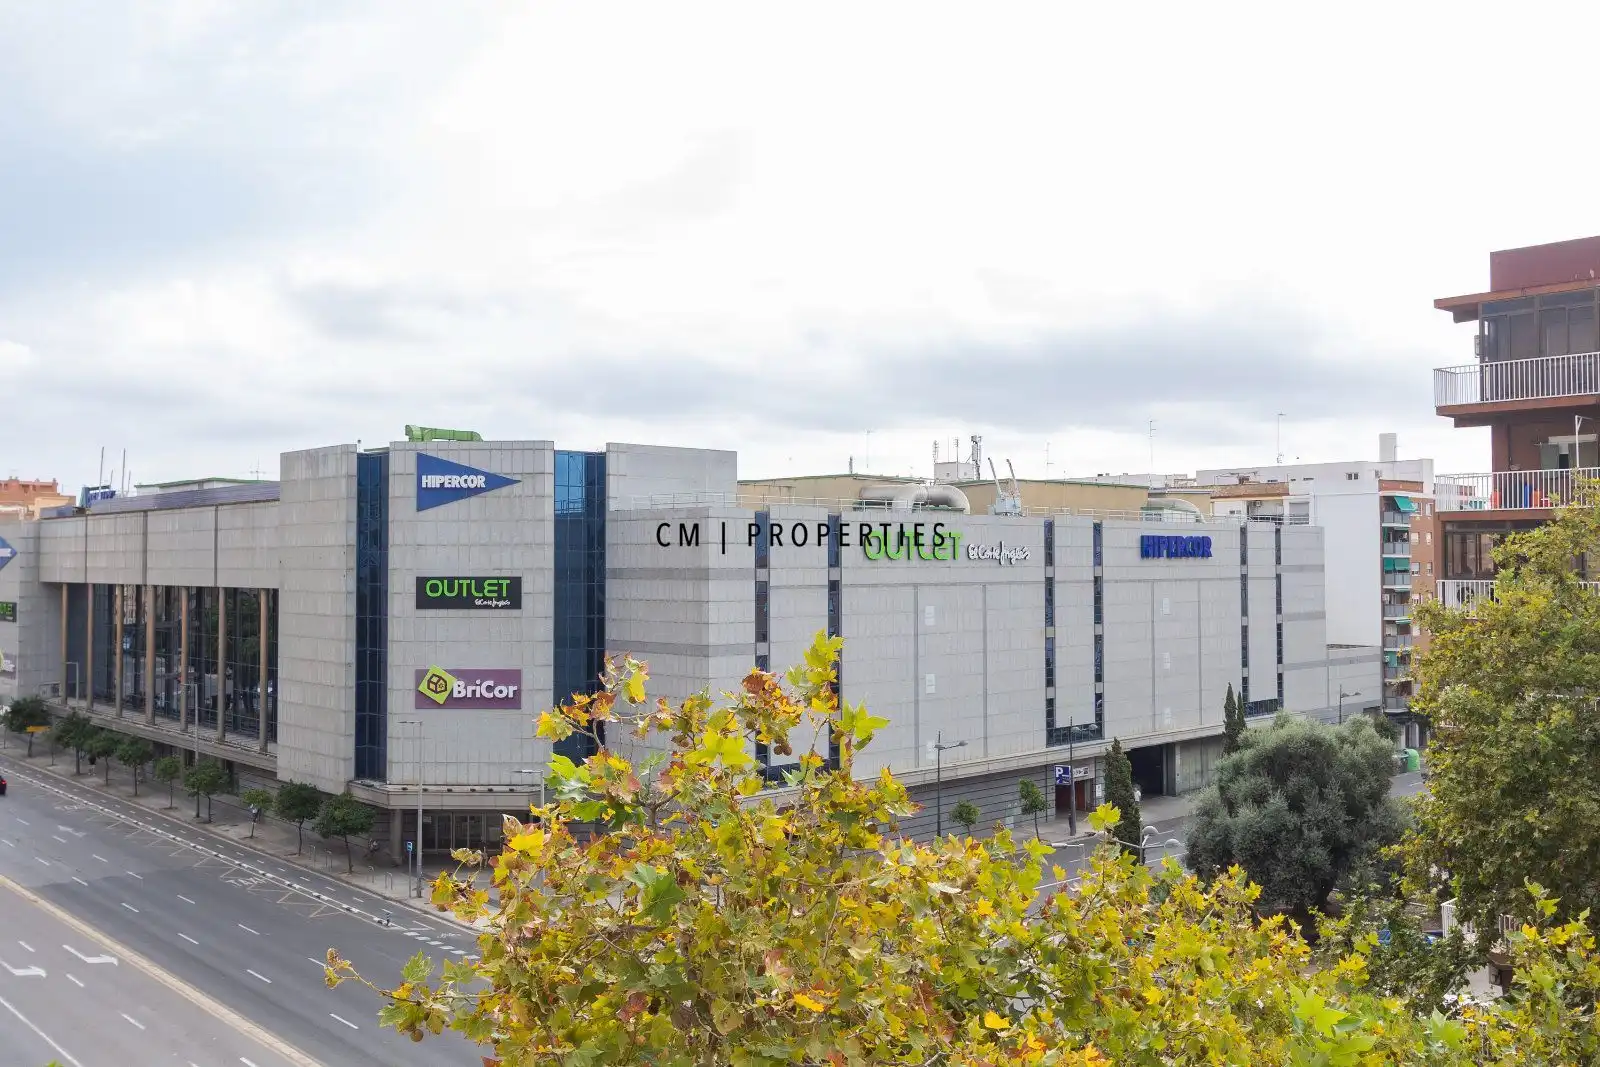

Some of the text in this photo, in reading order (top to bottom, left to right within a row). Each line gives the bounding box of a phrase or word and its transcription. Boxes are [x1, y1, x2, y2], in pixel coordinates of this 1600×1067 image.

[421, 475, 486, 488] HIPERCOR
[864, 530, 962, 560] OUTLET
[1140, 535, 1213, 558] HIPERCOR
[425, 579, 511, 598] OUTLET
[453, 679, 518, 699] BriCor
